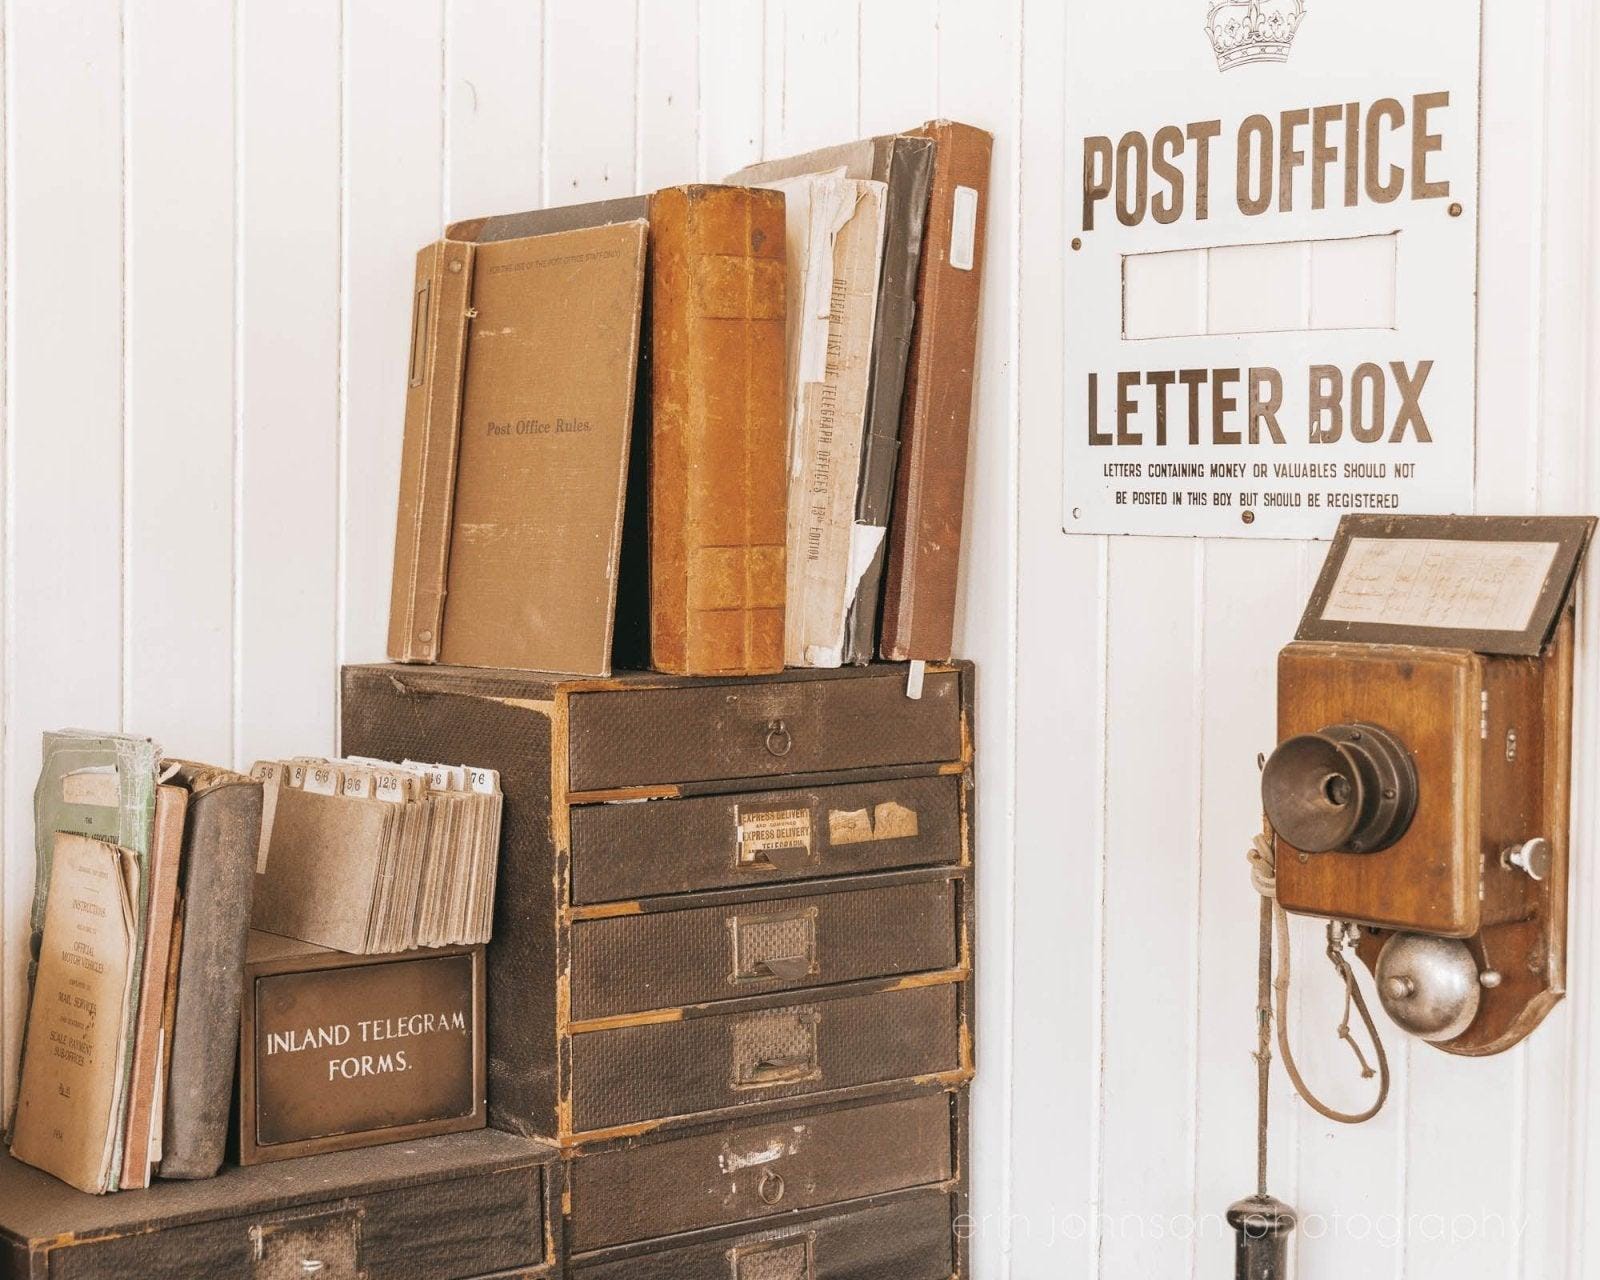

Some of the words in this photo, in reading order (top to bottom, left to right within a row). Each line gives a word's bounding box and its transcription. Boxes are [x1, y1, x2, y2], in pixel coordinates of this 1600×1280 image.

[1082, 119, 1221, 231] POST
[1236, 91, 1450, 216] OFFICE
[826, 334, 842, 358] LIST
[824, 363, 840, 378] OF
[1088, 367, 1287, 446] LETTER
[1308, 360, 1435, 445] BOX
[817, 384, 837, 444] TELEGRAPH
[486, 421, 512, 436] Post
[515, 419, 551, 435] Office
[813, 450, 831, 494] OFFICES
[1103, 463, 1142, 478] LETTERS
[1148, 463, 1205, 478] CONTAINING
[1210, 463, 1247, 478] MONEY
[1253, 463, 1268, 478] OR
[1274, 463, 1337, 478] VALUABLES
[1344, 463, 1386, 478] SHOULD
[1394, 463, 1416, 478] NOT
[1115, 491, 1127, 505] BE
[1132, 491, 1168, 506] POSTED
[1172, 491, 1183, 506] IN
[1187, 492, 1207, 506] THIS
[1213, 492, 1232, 507] BOX
[1239, 492, 1259, 507] BUT
[1263, 492, 1301, 507] SHOULD
[1307, 492, 1321, 508] BE
[1327, 492, 1399, 509] REGISTERED
[378, 775, 398, 791] 126
[470, 771, 486, 786] 76
[742, 813, 776, 824] EXPRESS
[776, 808, 809, 820] DELIVERY
[742, 829, 775, 842] EXPRESS
[776, 826, 809, 839] DELIVERY
[58, 991, 74, 1008] MAIL
[267, 1025, 350, 1055] INLAND
[357, 1010, 466, 1042] TELEGRAM
[50, 1030, 67, 1045] SCALE
[68, 1036, 94, 1057] PAYMENT
[328, 1051, 413, 1081] FORMS.
